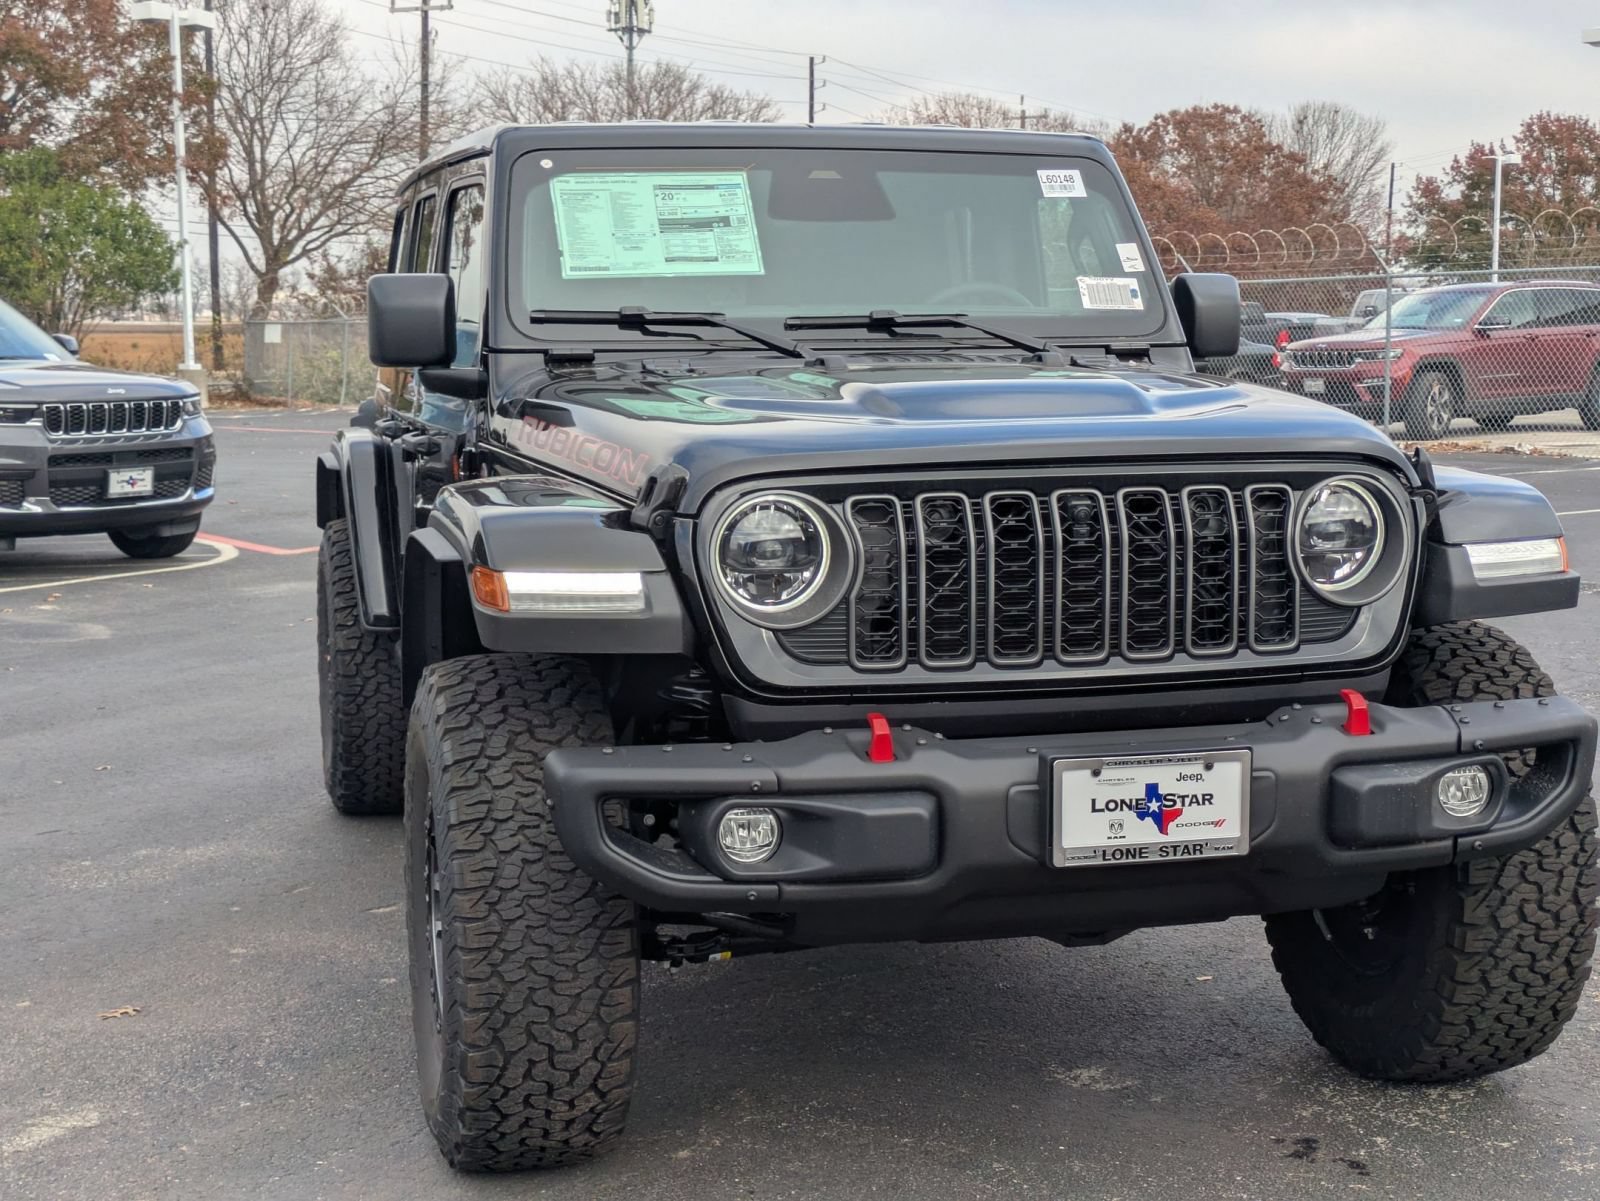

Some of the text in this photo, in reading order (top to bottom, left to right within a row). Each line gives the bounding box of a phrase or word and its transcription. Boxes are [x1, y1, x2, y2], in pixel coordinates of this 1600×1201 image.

[1040, 174, 1075, 184] L60148
[661, 192, 674, 201] 20
[519, 415, 650, 485] RUBICON
[1106, 757, 1164, 767] CHRYSLER
[1176, 772, 1203, 782] Jeep
[1091, 793, 1214, 813] LONE STAR
[1176, 820, 1217, 828] DODGE
